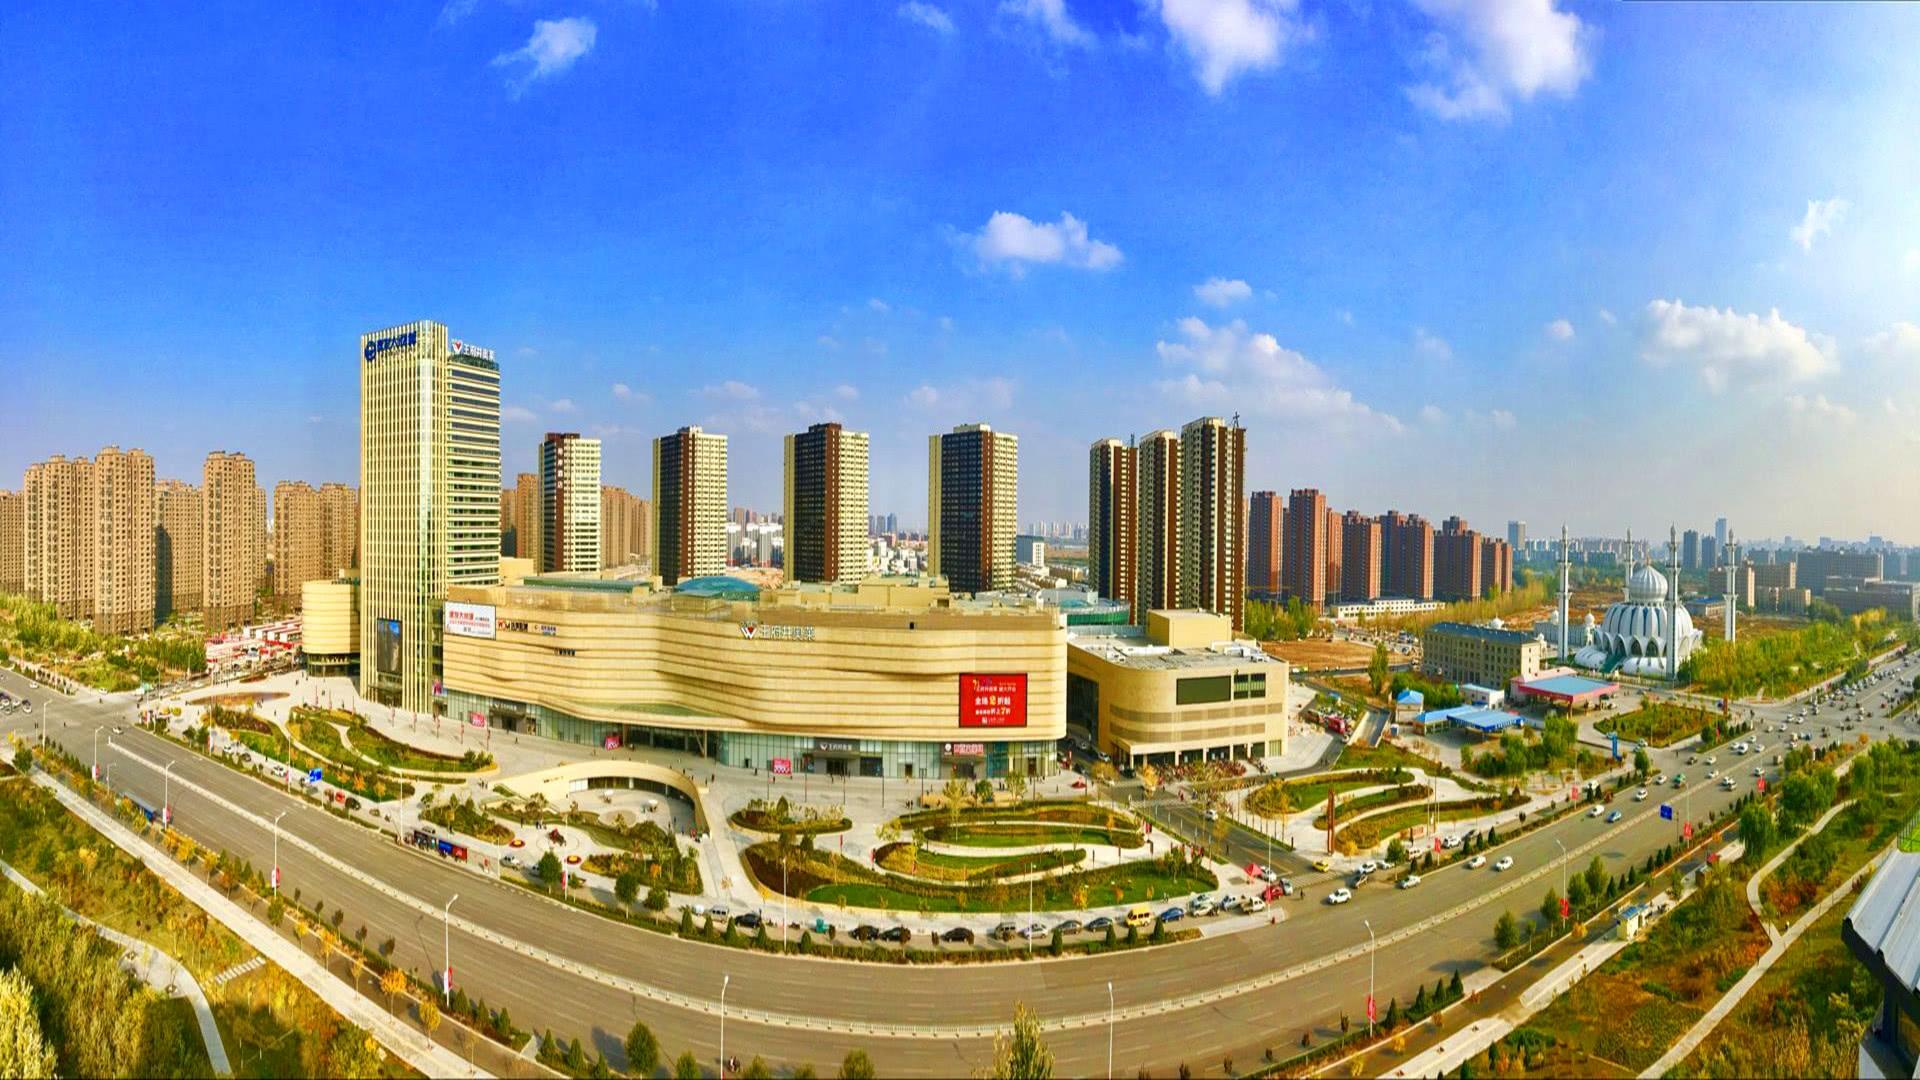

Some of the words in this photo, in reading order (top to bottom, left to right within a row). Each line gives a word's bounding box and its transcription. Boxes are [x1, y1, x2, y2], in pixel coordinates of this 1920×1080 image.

[760, 624, 816, 640] 王府井奥莱
